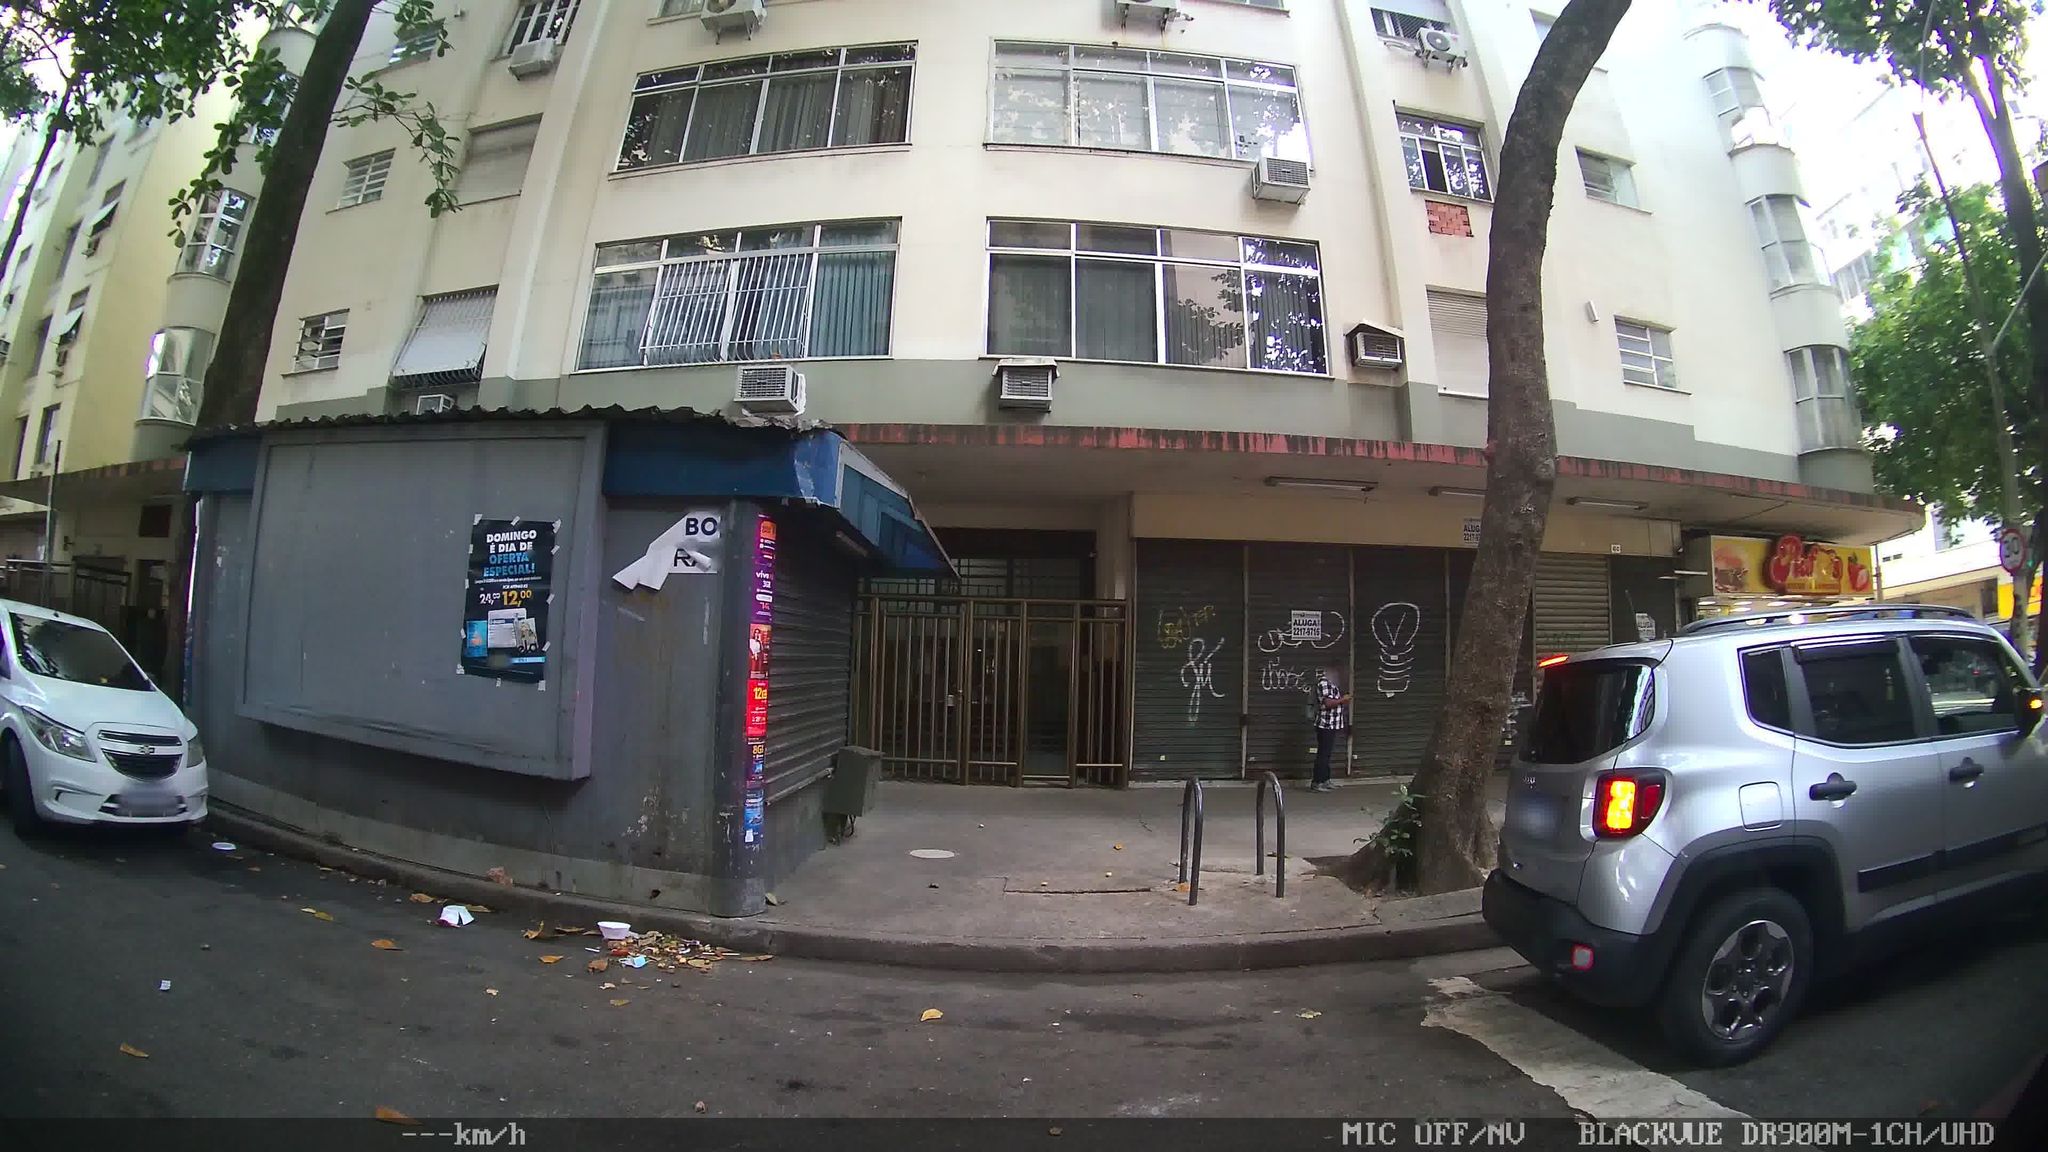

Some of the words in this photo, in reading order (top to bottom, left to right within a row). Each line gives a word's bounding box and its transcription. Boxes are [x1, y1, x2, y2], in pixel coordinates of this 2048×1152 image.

[486, 530, 537, 543] DOMINGO
[489, 543, 496, 554] É
[498, 543, 516, 552] DIA
[519, 541, 533, 551] DE
[489, 552, 530, 564] OFERTA
[483, 563, 536, 577] ESPECIAL!
